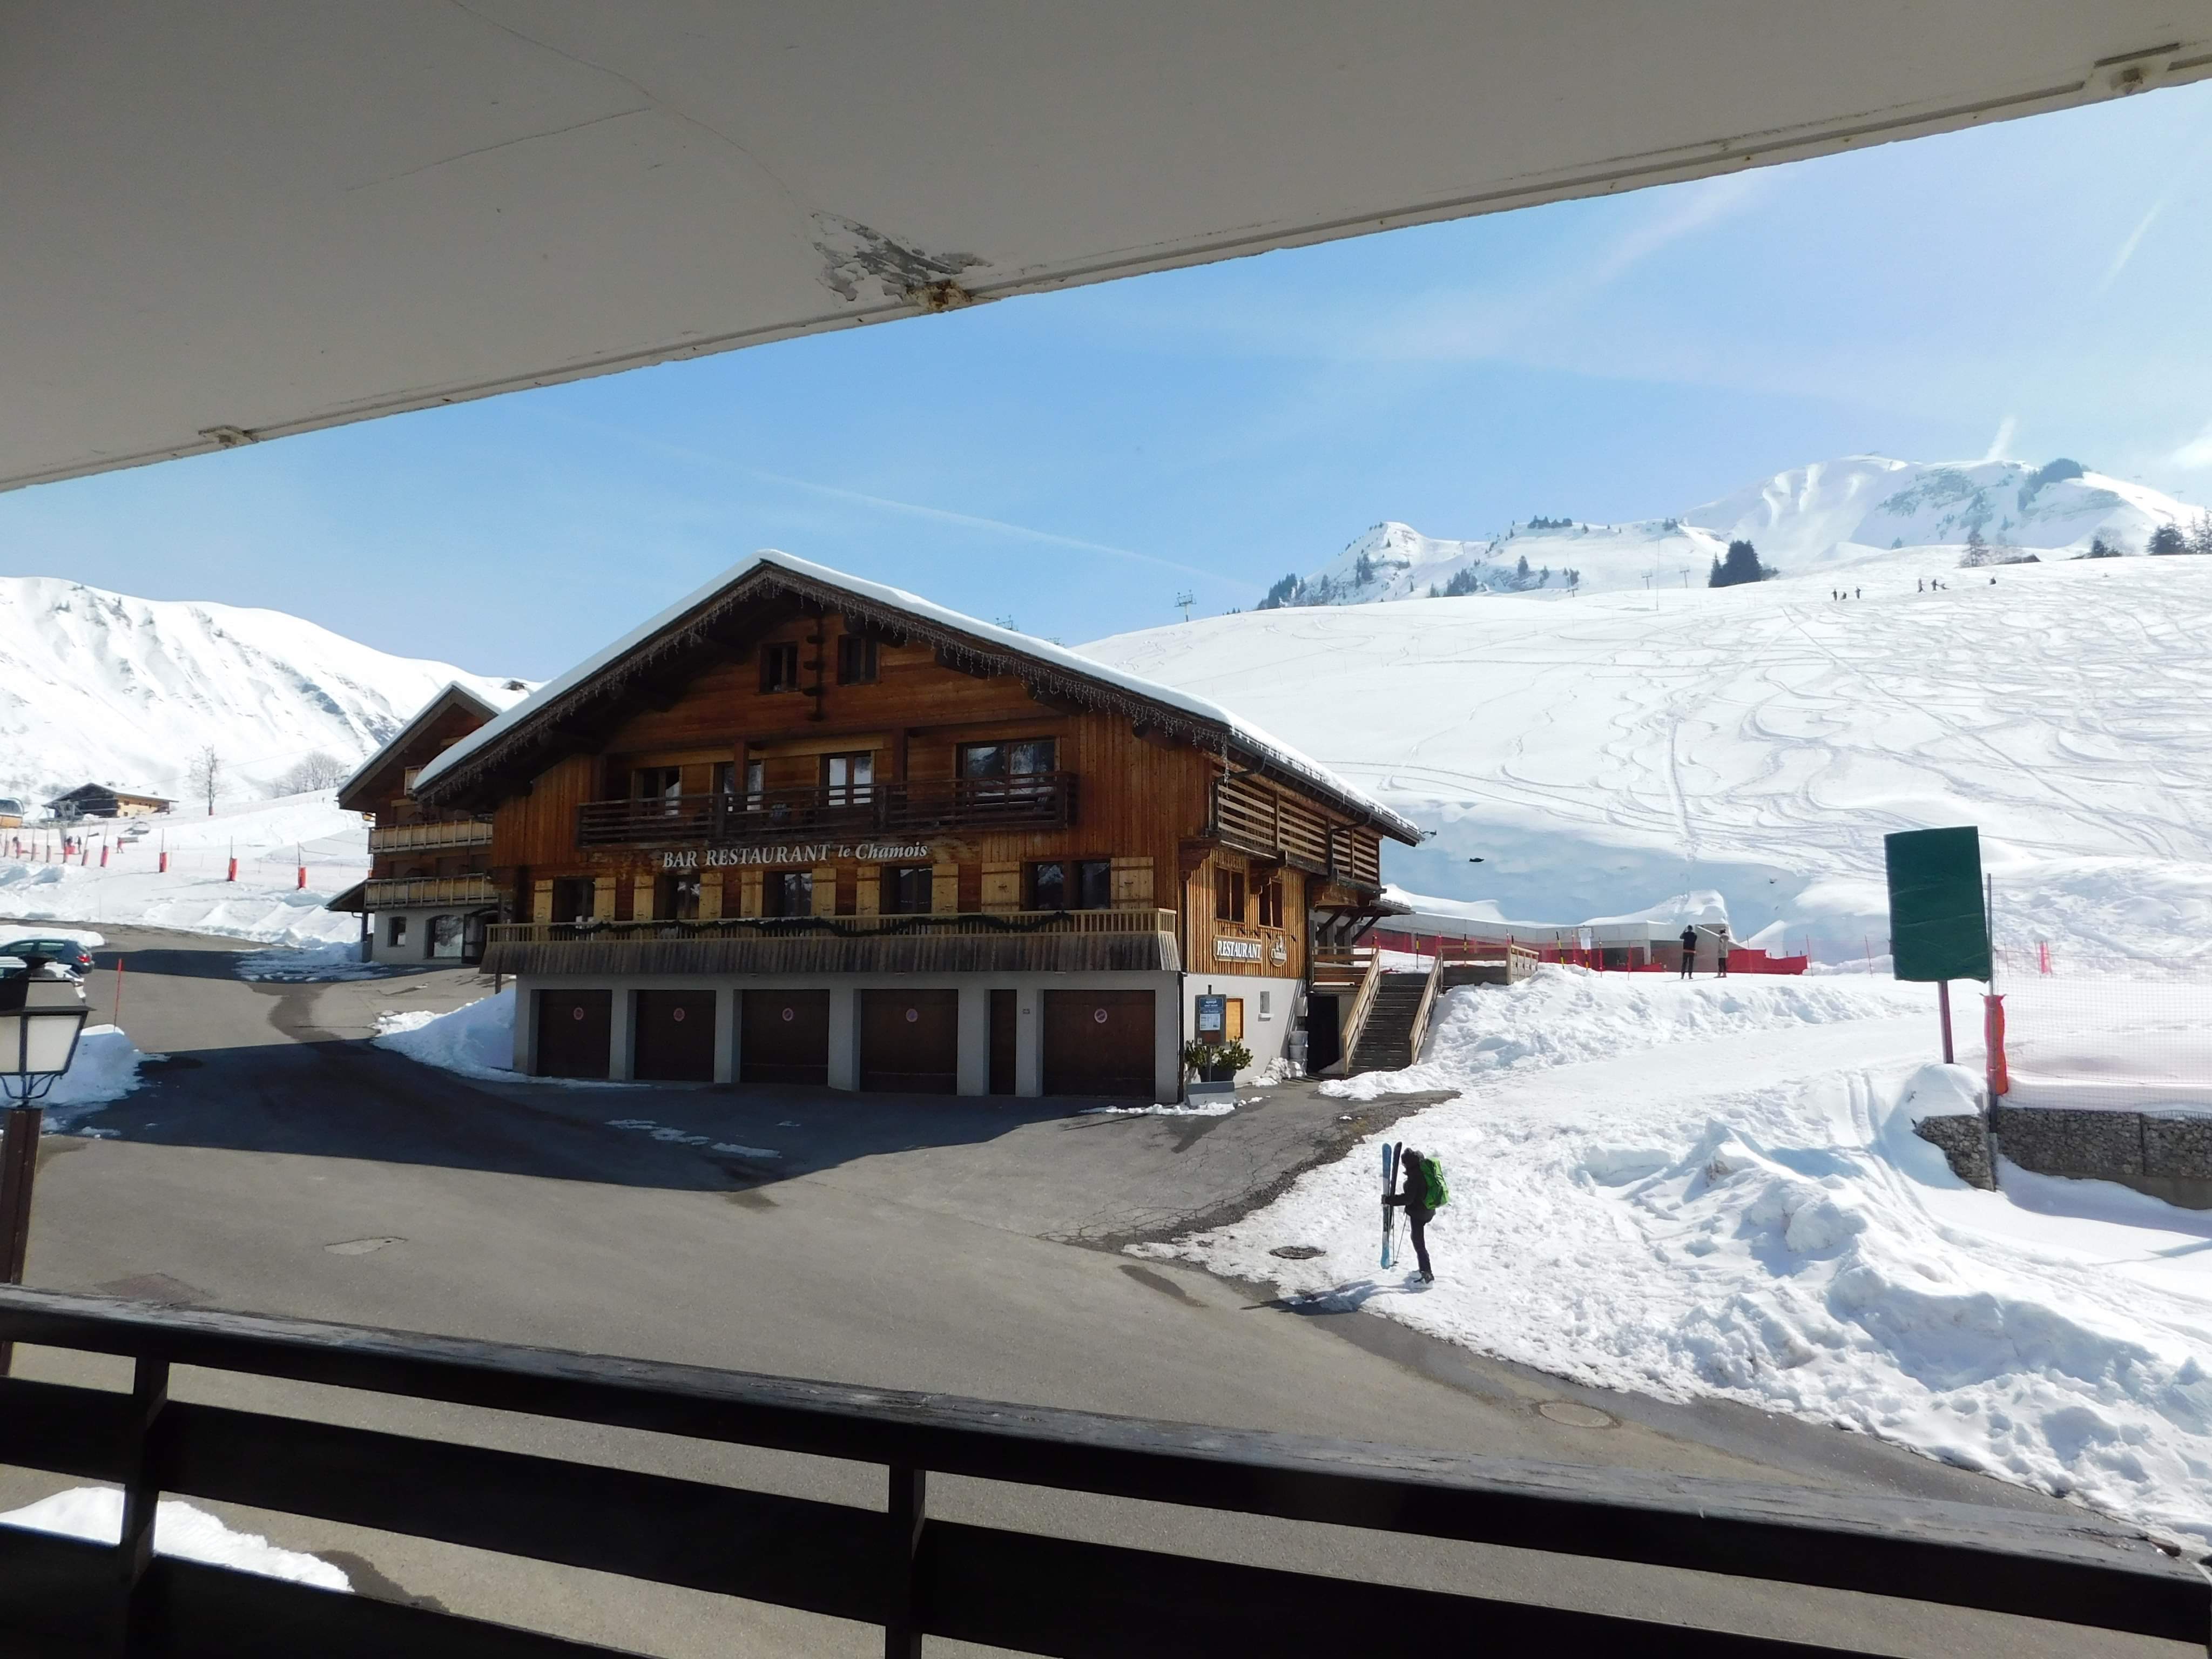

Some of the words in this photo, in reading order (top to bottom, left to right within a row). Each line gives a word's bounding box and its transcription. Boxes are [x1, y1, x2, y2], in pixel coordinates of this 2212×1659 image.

[662, 851, 698, 868] BAR
[705, 844, 831, 866] RESTAURANT
[838, 845, 851, 858] le
[855, 841, 928, 859] Chamois
[1217, 940, 1262, 959] RESTAURANT
